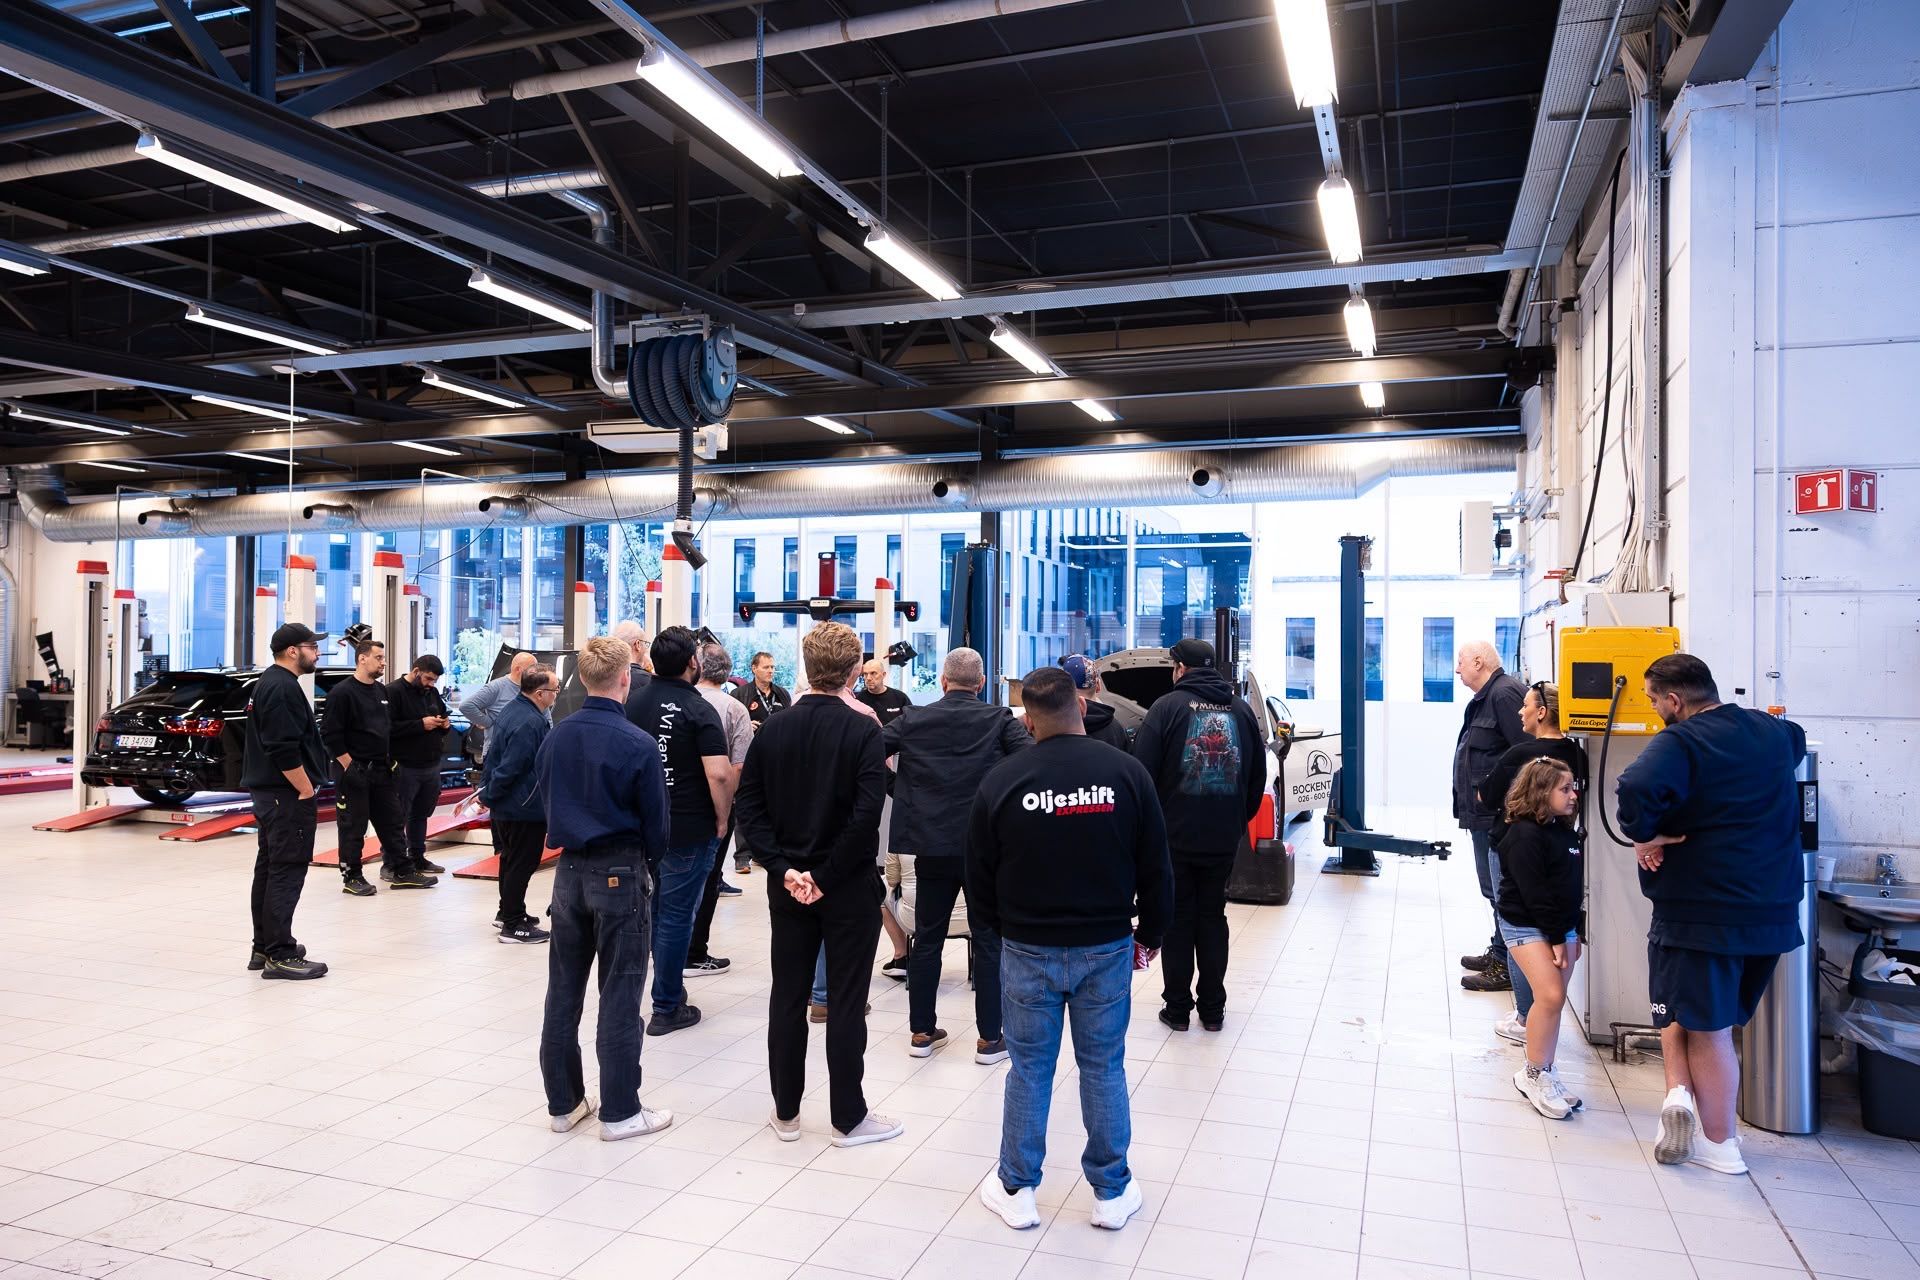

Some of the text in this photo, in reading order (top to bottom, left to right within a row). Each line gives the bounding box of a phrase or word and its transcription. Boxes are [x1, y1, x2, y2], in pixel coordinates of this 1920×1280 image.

[1199, 702, 1232, 711] MAGIC
[660, 714, 675, 730] Vi
[1569, 718, 1589, 726] Atlas
[120, 736, 154, 746] ZZ 34789
[658, 734, 672, 763] kan
[1022, 785, 1115, 814] Oljeskift
[1298, 794, 1310, 803] 026
[1313, 791, 1326, 801] 600
[1055, 803, 1115, 816] EXPRESSEN
